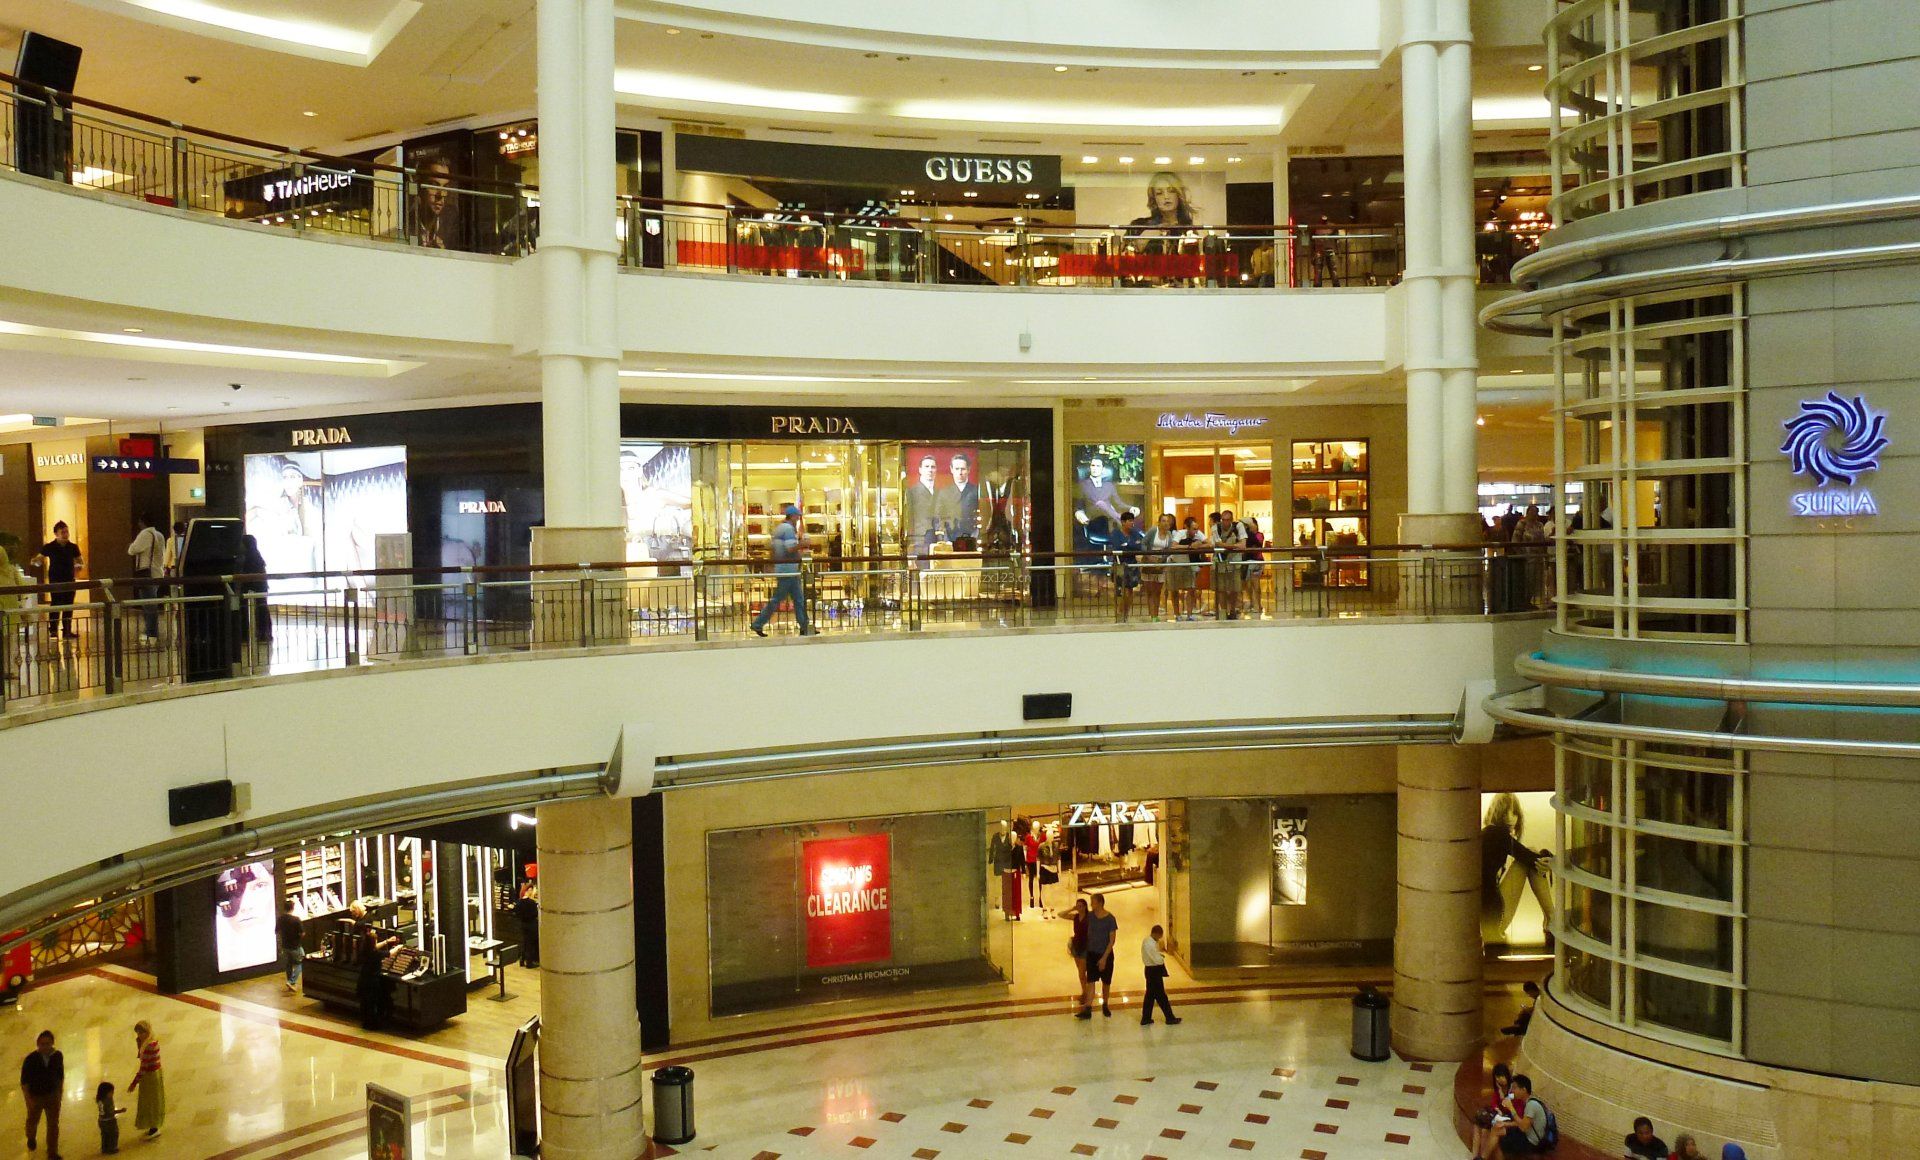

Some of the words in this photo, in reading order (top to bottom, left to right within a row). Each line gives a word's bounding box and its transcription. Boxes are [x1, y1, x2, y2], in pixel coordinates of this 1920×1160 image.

[925, 157, 1033, 183] GUESS
[771, 416, 859, 434] PRADA
[291, 426, 352, 446] PRADA
[37, 452, 84, 467] BVLGARI
[459, 500, 507, 514] PRADA
[1791, 490, 1878, 515] SURIA
[1067, 801, 1152, 826] ZARA
[821, 864, 873, 885] SSON'S
[807, 888, 887, 918] CLEARANCE
[821, 973, 863, 985] CHRISTMAS
[864, 967, 910, 980] PROMOTION
